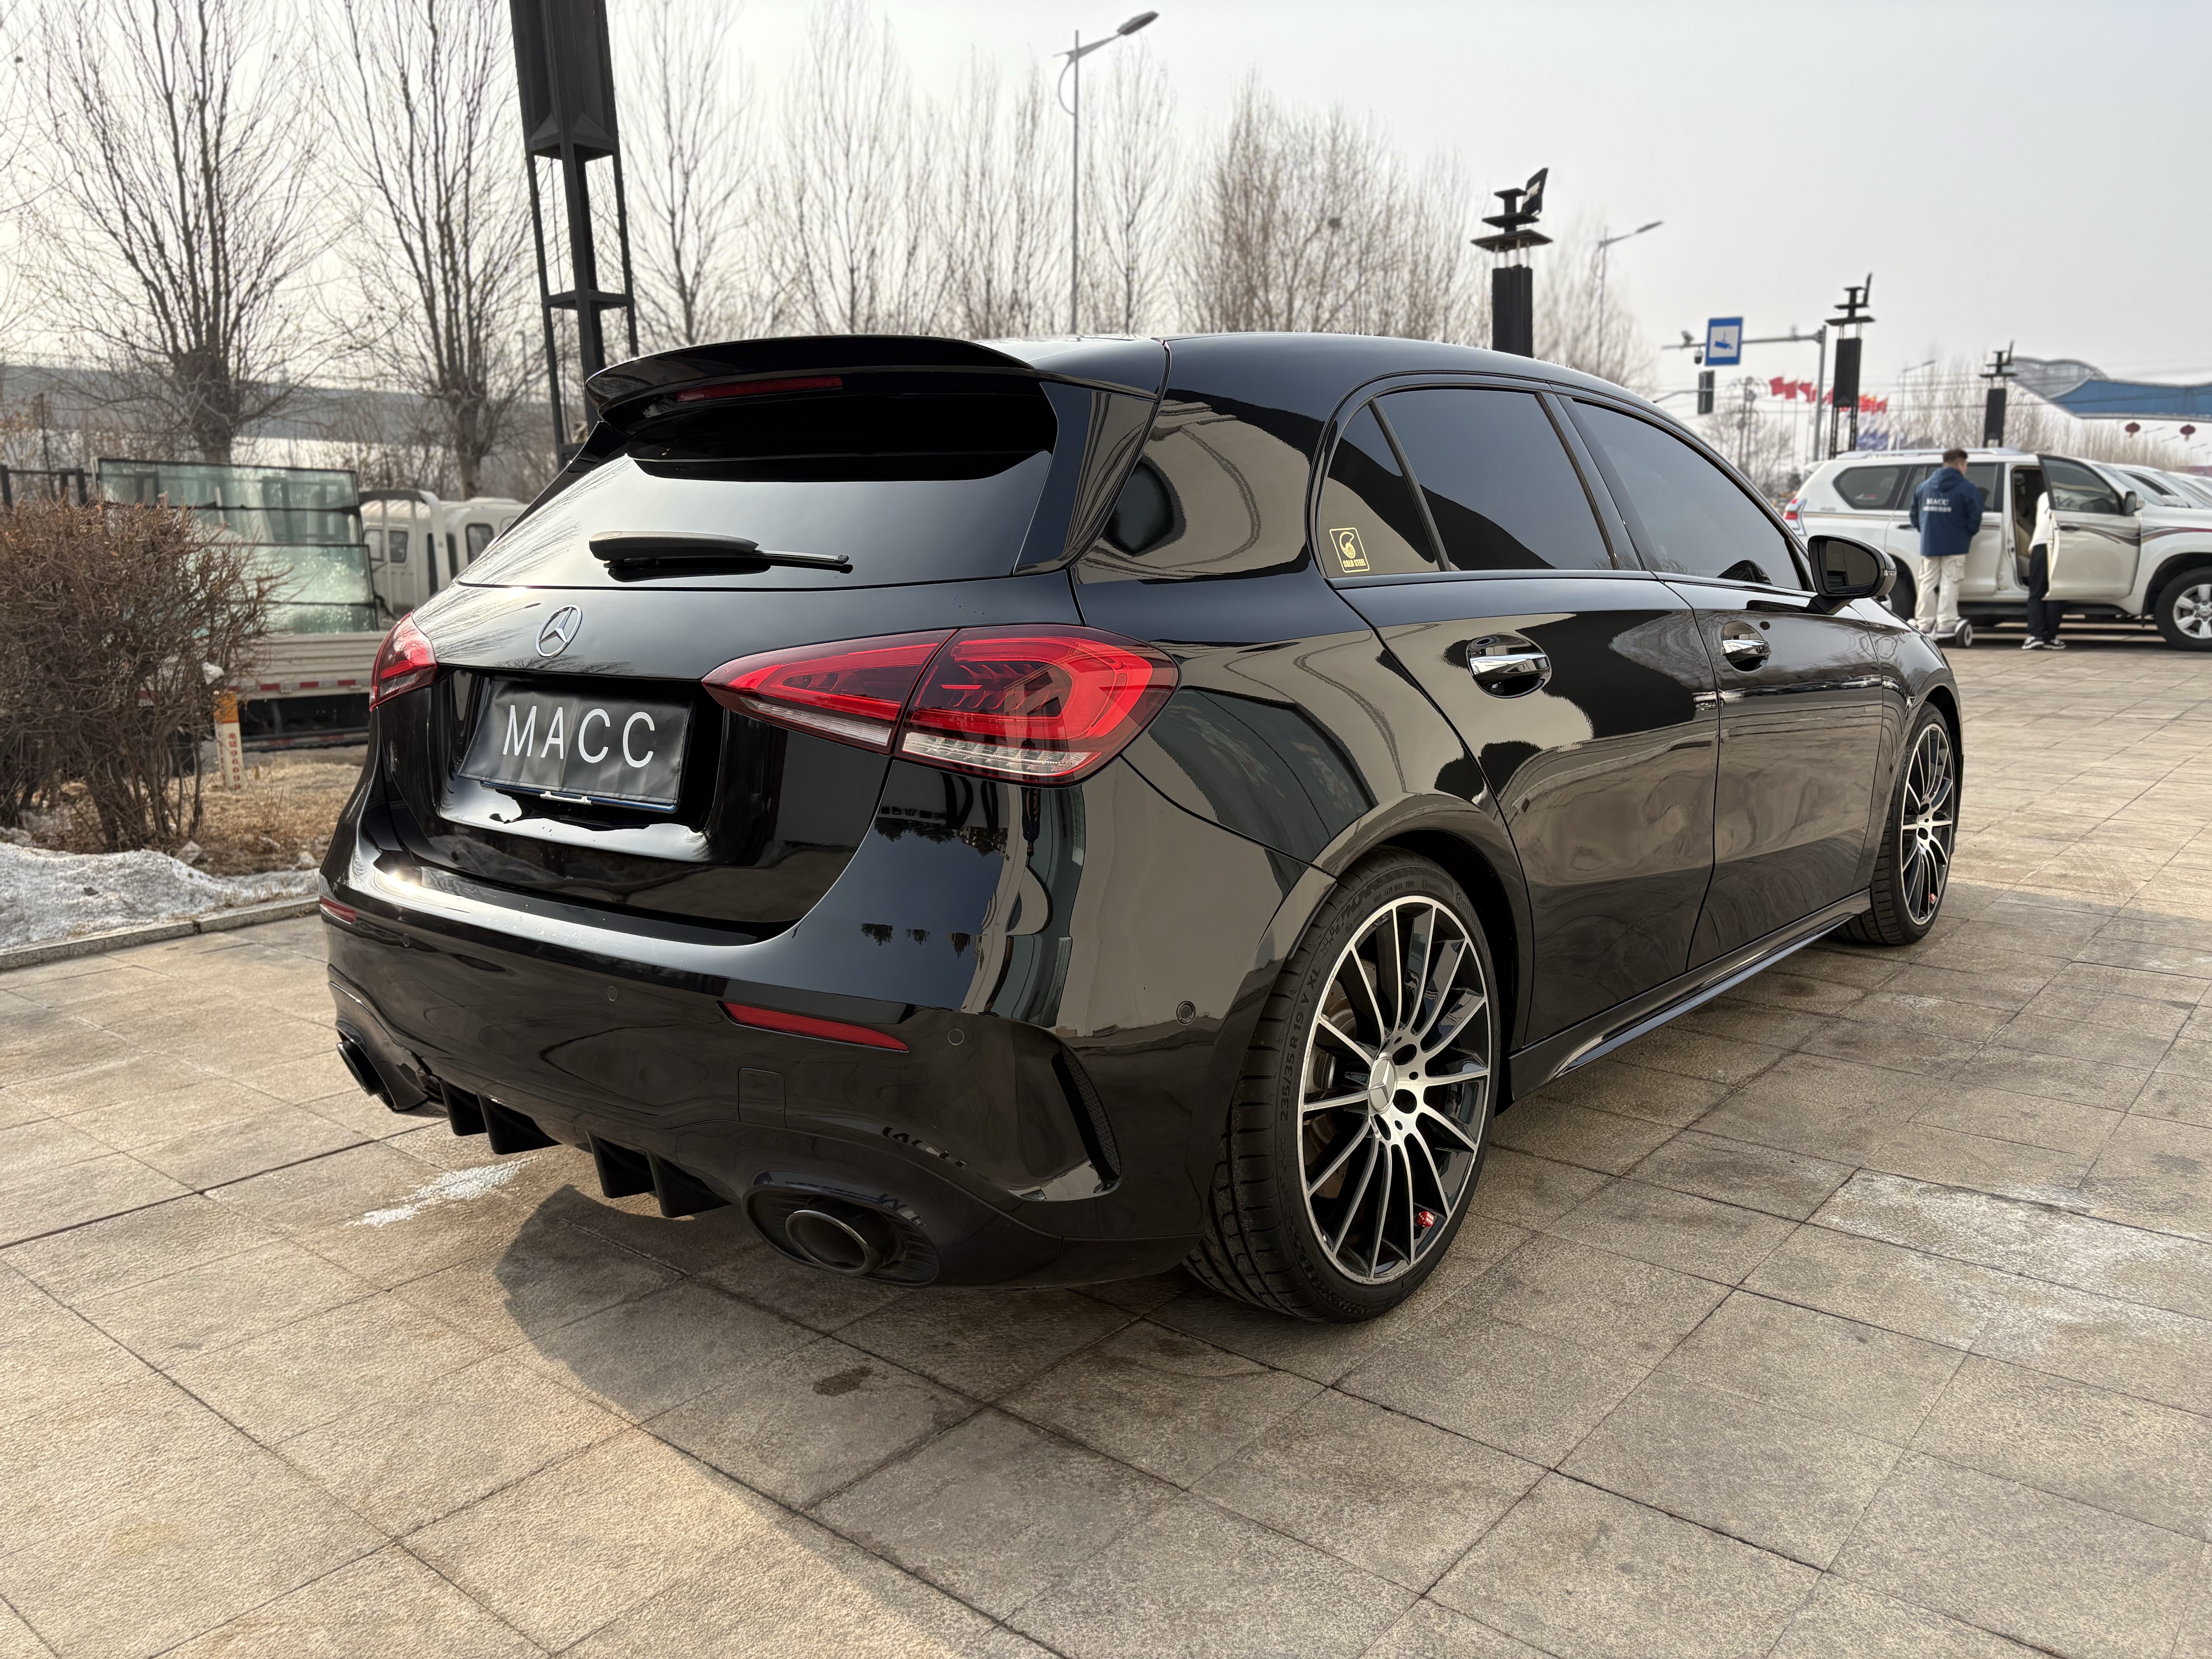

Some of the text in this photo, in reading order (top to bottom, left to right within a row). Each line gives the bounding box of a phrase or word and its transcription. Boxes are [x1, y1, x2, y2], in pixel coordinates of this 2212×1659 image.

[1343, 559, 1366, 568] COLD STEEL
[503, 705, 655, 768] MACC
[1456, 892, 1486, 948] Continental
[1280, 1053, 1295, 1121] 235/35
[1289, 1036, 1299, 1049] R
[1294, 1011, 1304, 1032] 19
[1300, 992, 1309, 1004] Y
[1307, 969, 1321, 990] XL
